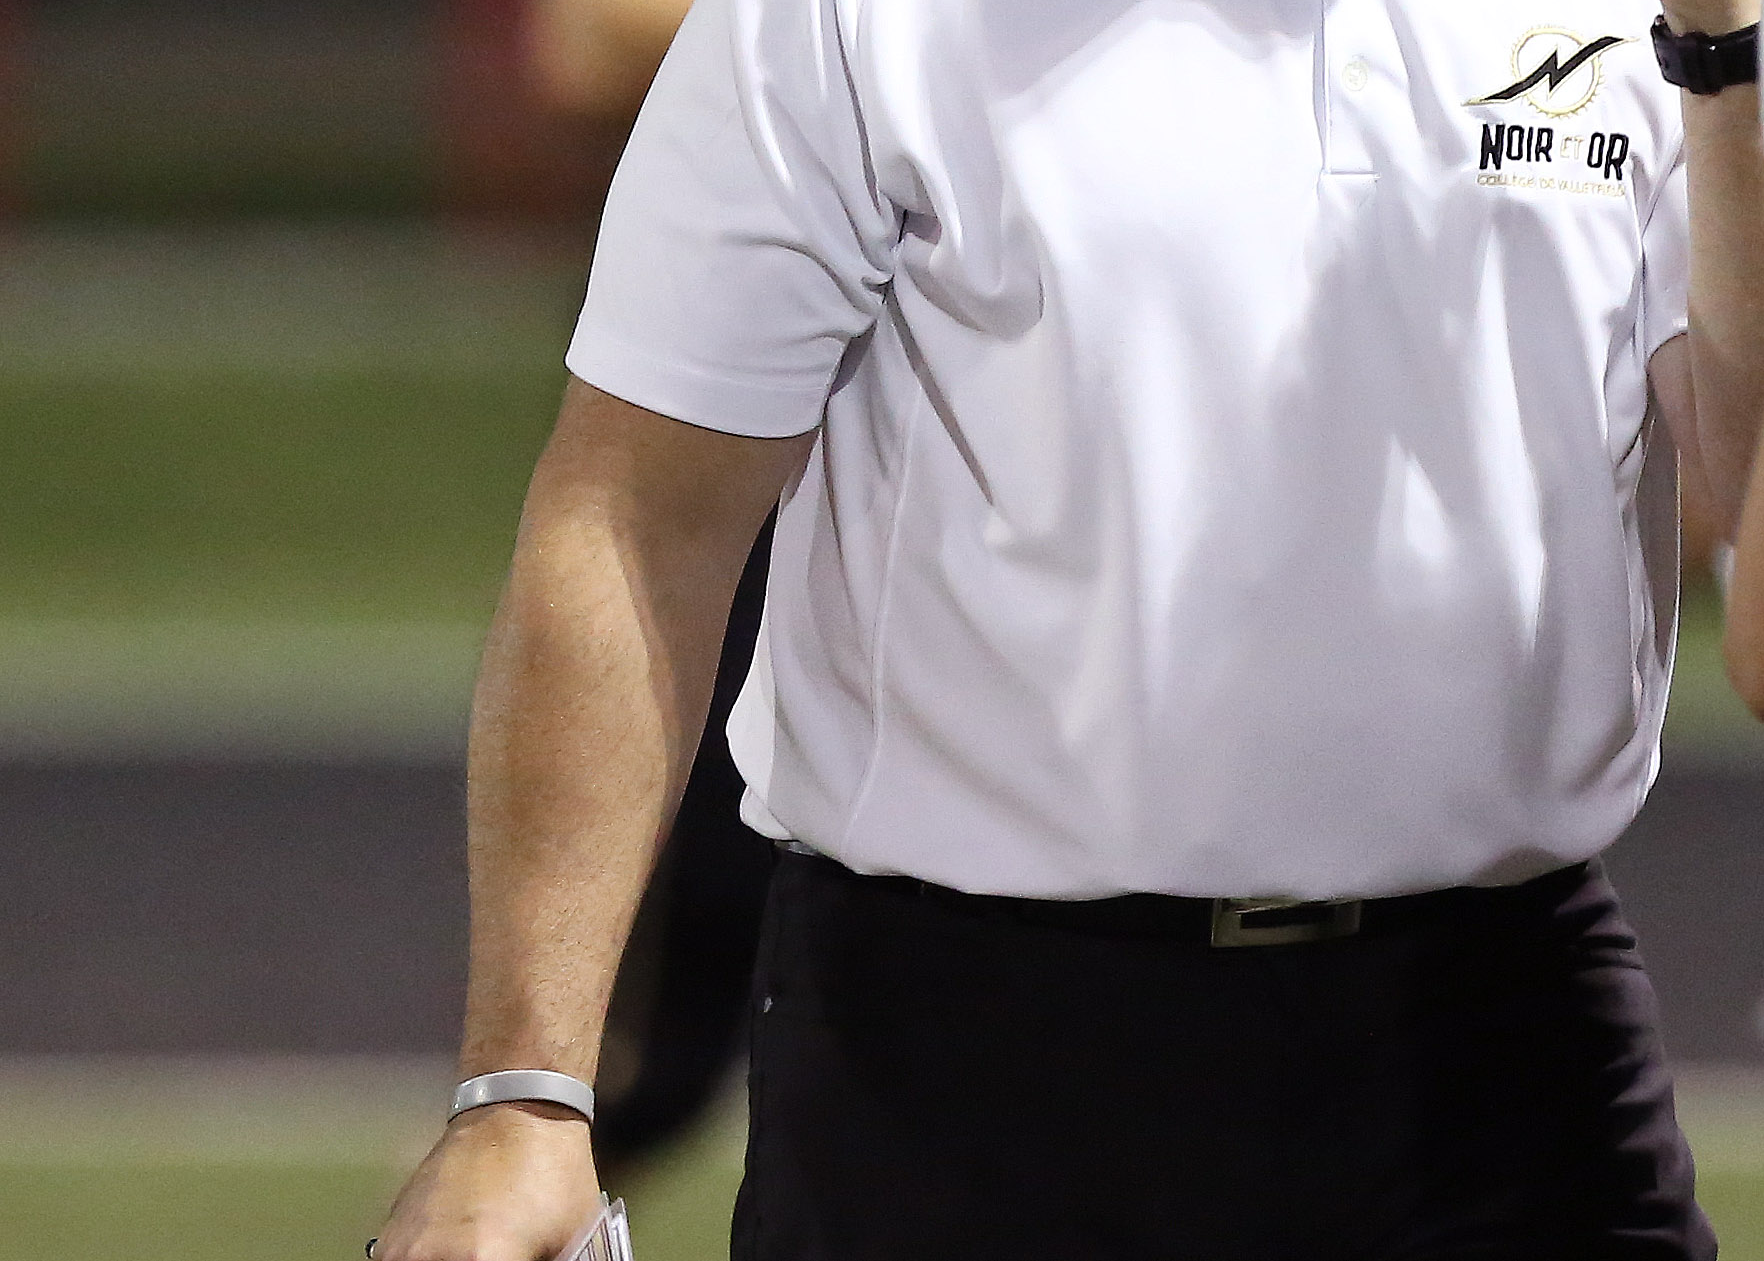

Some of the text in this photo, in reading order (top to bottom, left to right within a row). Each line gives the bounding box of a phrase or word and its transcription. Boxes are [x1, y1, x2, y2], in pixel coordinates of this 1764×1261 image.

[1479, 123, 1629, 180] NOIR ET OR
